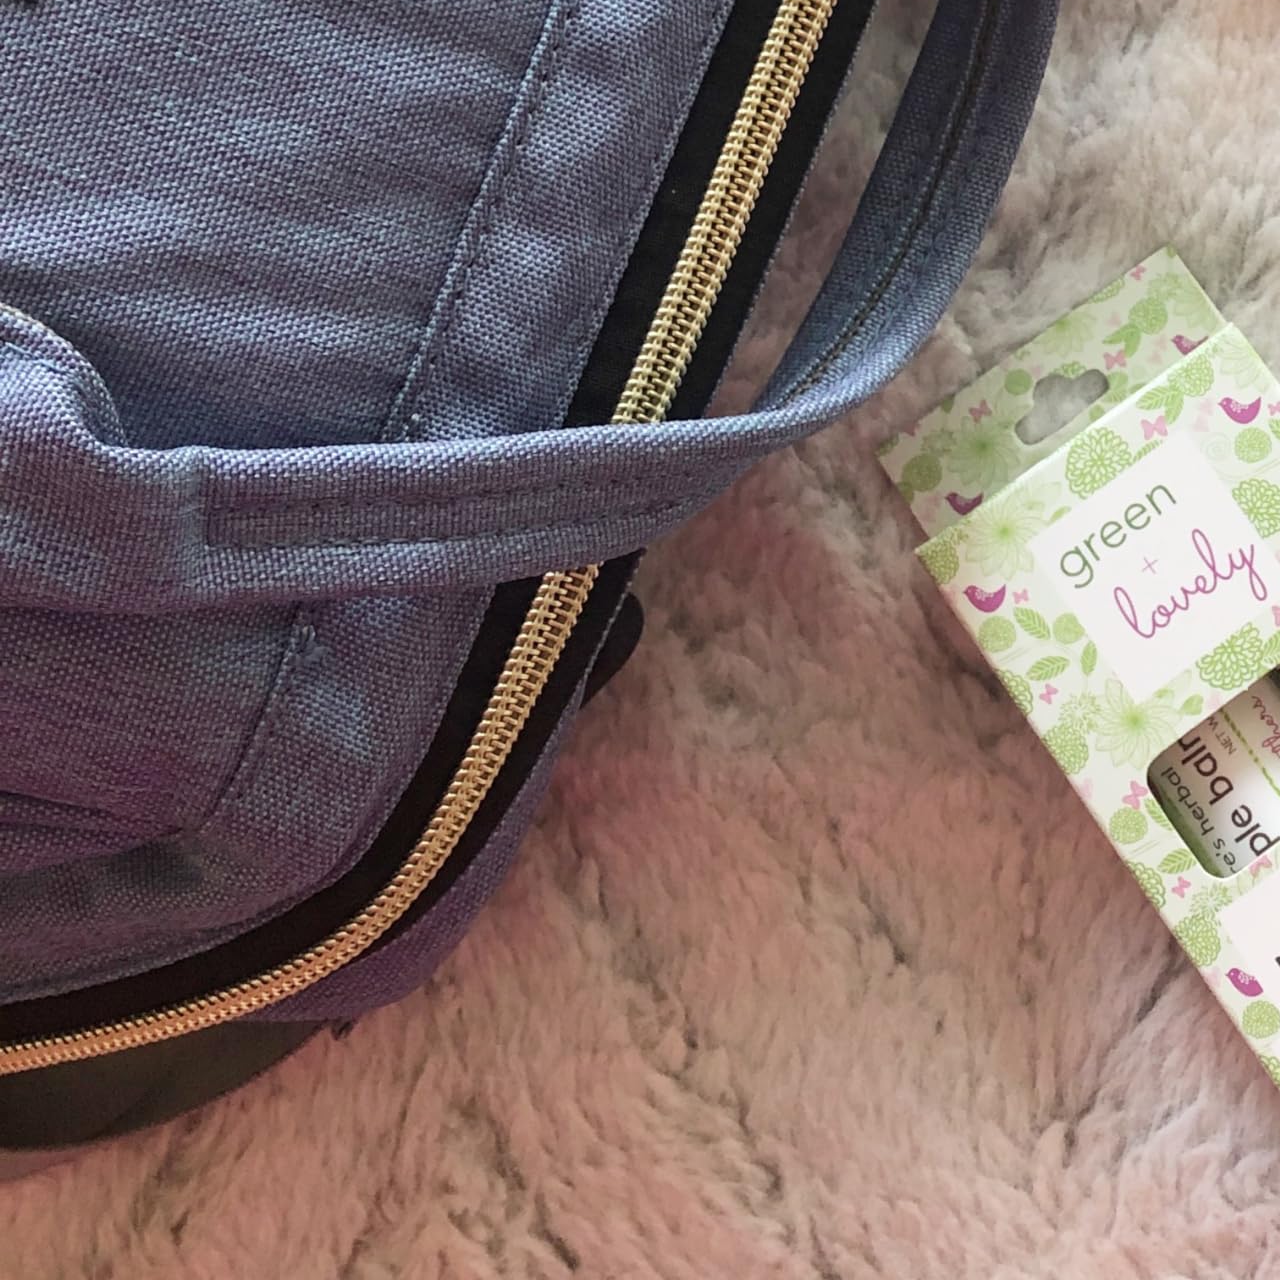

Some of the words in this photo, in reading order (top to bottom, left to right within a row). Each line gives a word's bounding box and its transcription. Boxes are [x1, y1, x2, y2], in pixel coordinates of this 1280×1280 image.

[1060, 485, 1177, 589] green
[1113, 528, 1268, 639] lovely
[1215, 729, 1237, 756] NET
[1161, 766, 1215, 836] herbal
